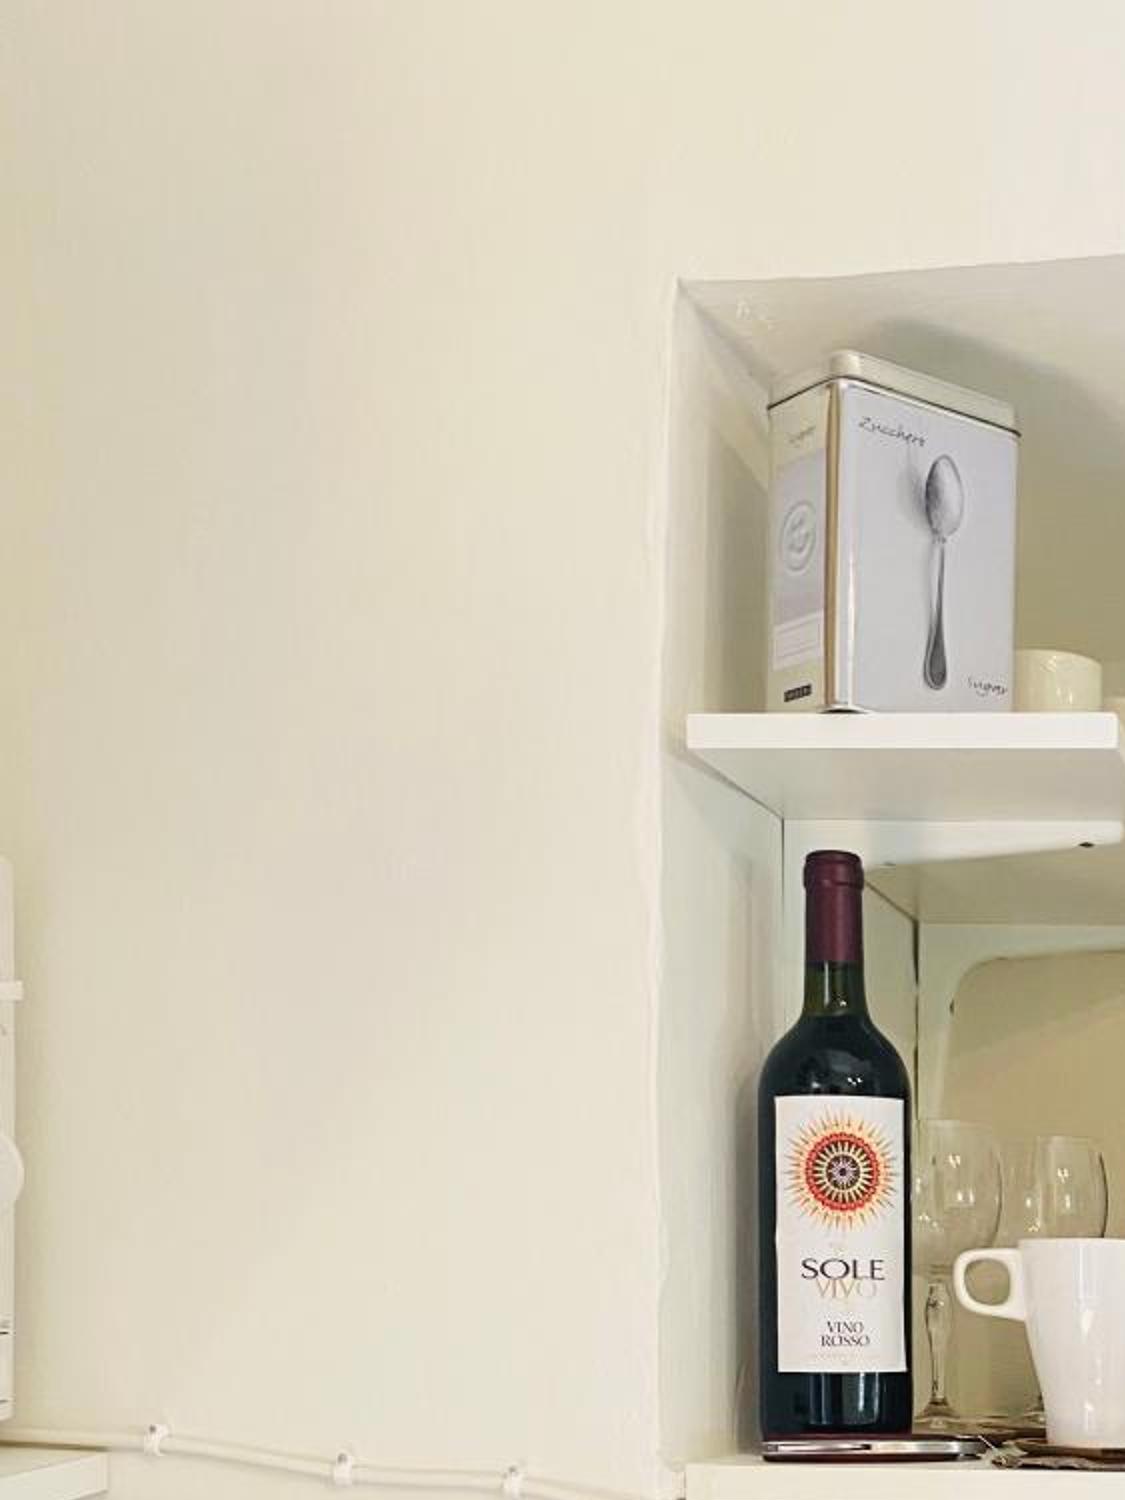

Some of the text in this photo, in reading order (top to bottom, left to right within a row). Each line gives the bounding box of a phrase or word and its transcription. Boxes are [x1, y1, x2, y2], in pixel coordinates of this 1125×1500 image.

[801, 1258, 885, 1280] SOLE
[816, 1279, 877, 1298] VIVO
[826, 1321, 864, 1333] VINO
[821, 1335, 870, 1347] ROSSO
